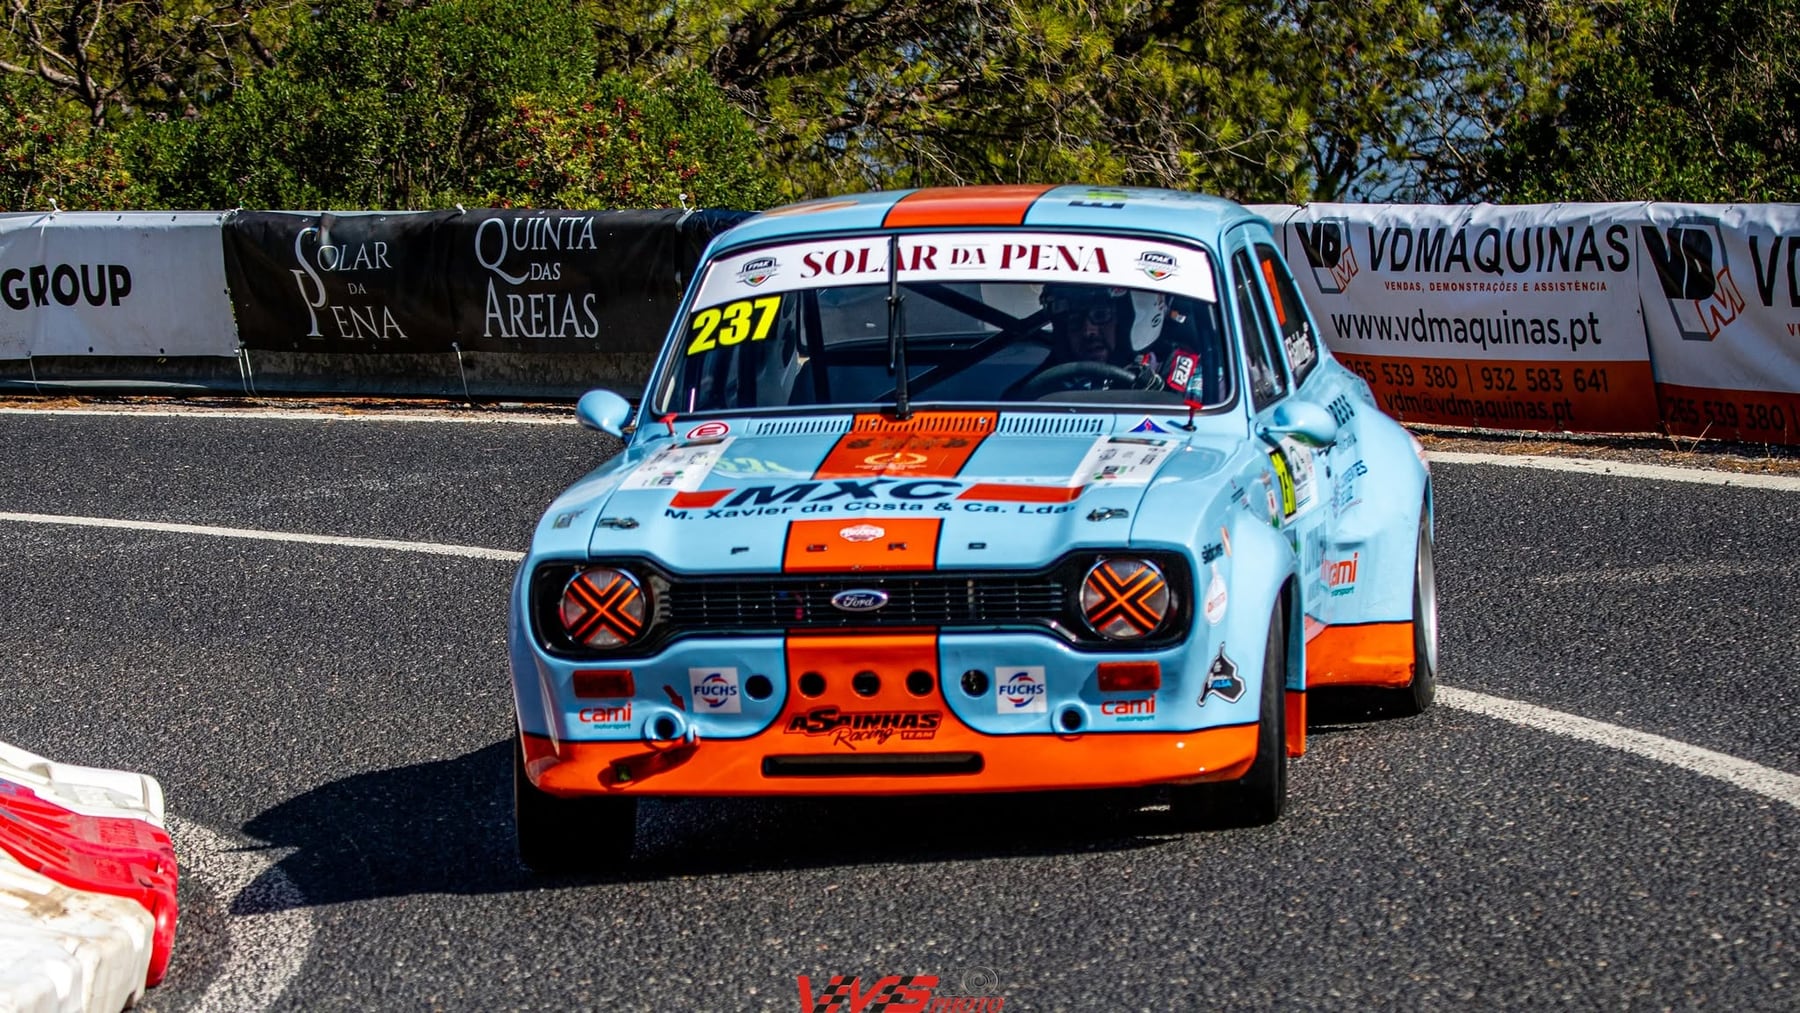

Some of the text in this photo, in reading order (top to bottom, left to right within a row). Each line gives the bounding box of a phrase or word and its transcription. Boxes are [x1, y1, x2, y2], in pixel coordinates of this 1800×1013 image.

[475, 216, 597, 284] QUINTA
[800, 244, 1110, 278] SOLAR DA PENA
[1368, 218, 1630, 276] VDMÁQUINAS
[530, 263, 561, 280] DAS
[0, 263, 132, 310] GROUP
[349, 283, 367, 295] DA
[1384, 280, 1607, 294] VENDAS, DEMONSTRAÇÕES E ASSISTÊNCIA
[289, 269, 407, 338] PENA
[483, 277, 599, 338] AREIAS
[687, 296, 781, 356] 237
[1331, 308, 1601, 351] www.vdmaquinas.pt
[1381, 363, 1414, 387] 539
[1422, 366, 1457, 389] 380
[1481, 367, 1517, 391] 932
[1525, 368, 1563, 392] 583
[1573, 369, 1609, 393] 641
[1383, 391, 1574, 423] vdm@vdmaquinas.pt
[1703, 400, 1738, 428] 539
[1743, 403, 1785, 431] 380
[723, 479, 963, 508] MXC
[664, 509, 693, 520] M.
[704, 505, 792, 519] Xavier
[801, 502, 833, 513] da
[844, 502, 923, 511] Costa
[933, 502, 952, 511] &
[964, 502, 1006, 514] Ca.
[842, 594, 875, 607] Ford
[694, 685, 737, 696] FUCHS
[999, 684, 1044, 695] FUCHS
[579, 703, 631, 722] cami
[1101, 695, 1155, 715] cami
[833, 728, 894, 750] Racing
